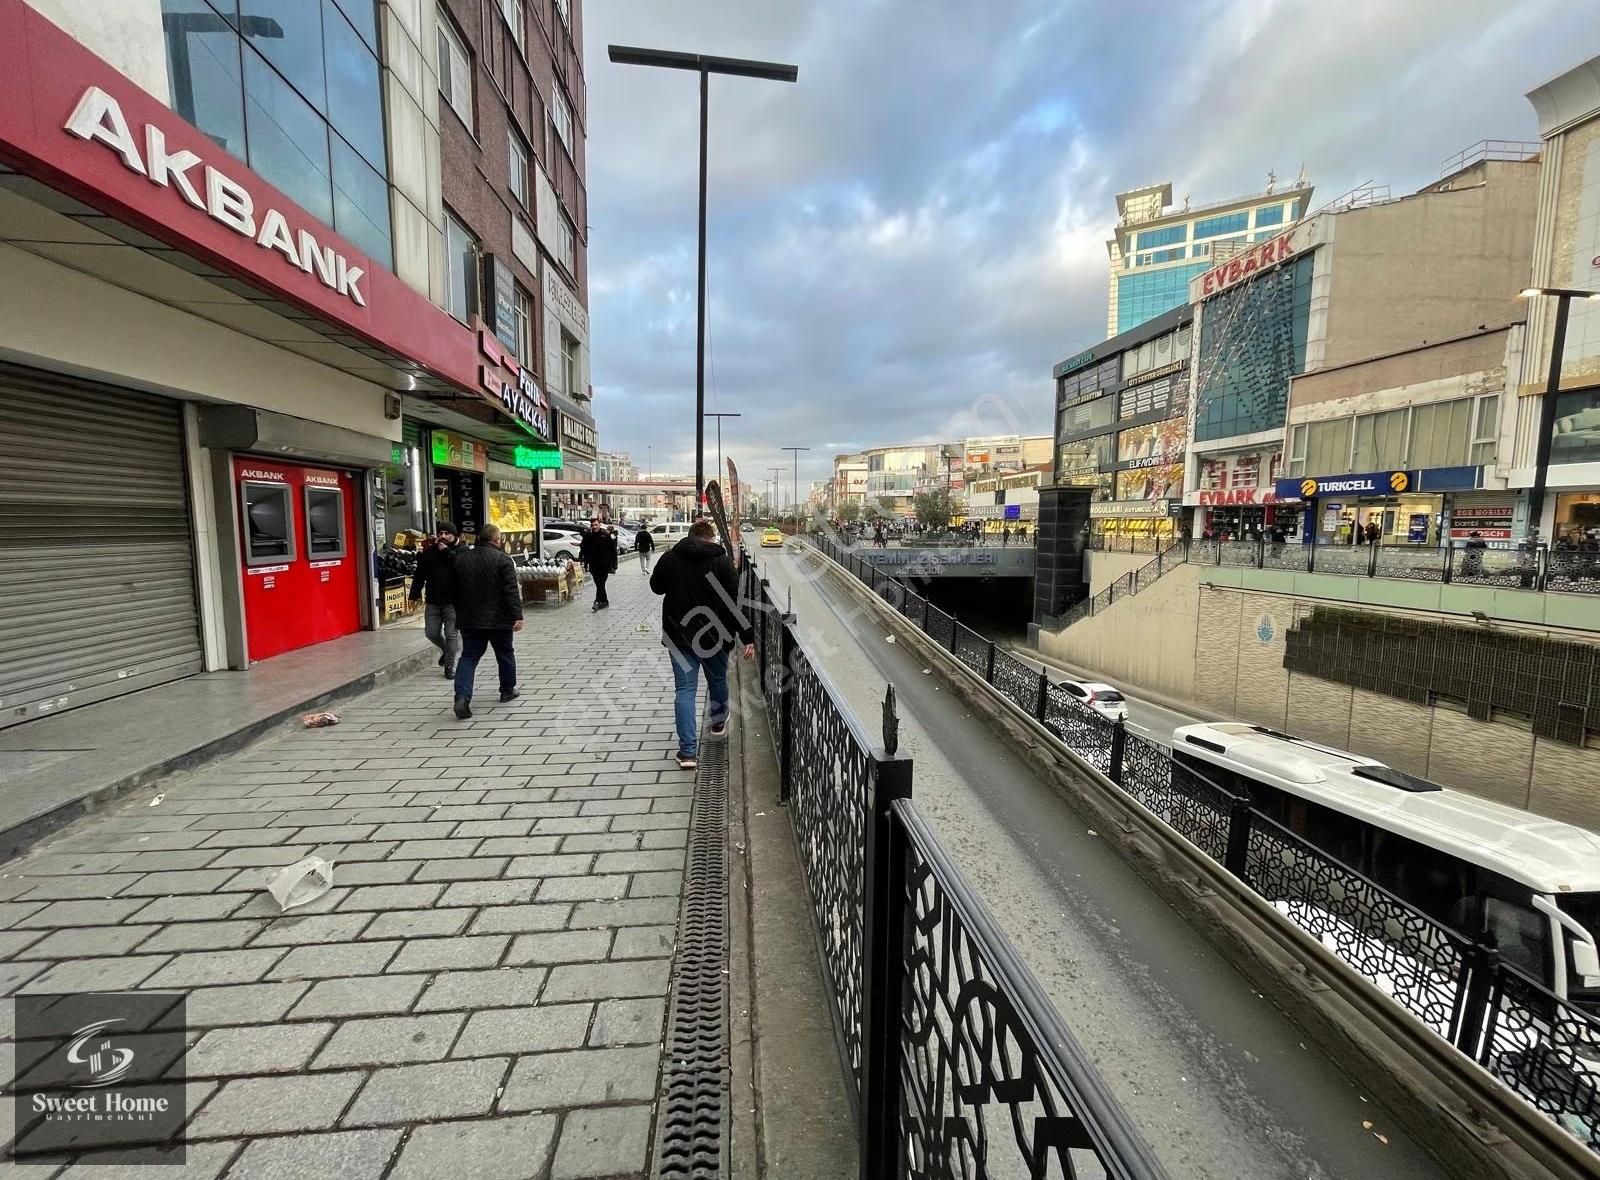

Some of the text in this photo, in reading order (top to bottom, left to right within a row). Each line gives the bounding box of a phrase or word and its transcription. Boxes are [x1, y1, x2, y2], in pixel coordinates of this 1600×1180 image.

[64, 86, 368, 308] AKBANK
[1202, 230, 1297, 295] EVBARK
[520, 367, 541, 407] Fatih
[503, 383, 550, 439] AYAKKABI
[241, 469, 285, 481] AKBANK
[305, 475, 338, 486] AKBANK
[1318, 480, 1375, 492] TURKCELL
[1200, 489, 1257, 505] EVBARK
